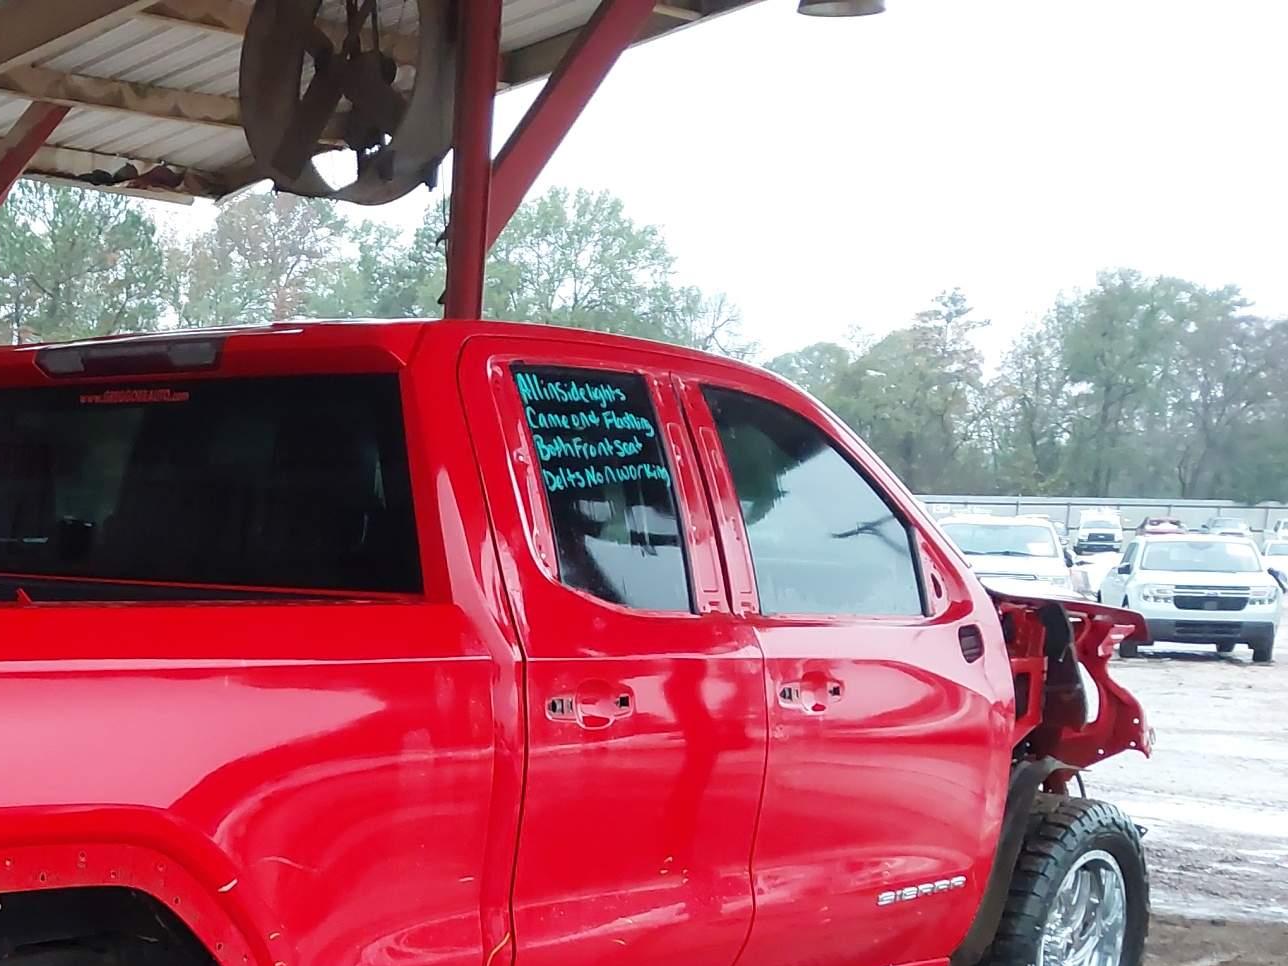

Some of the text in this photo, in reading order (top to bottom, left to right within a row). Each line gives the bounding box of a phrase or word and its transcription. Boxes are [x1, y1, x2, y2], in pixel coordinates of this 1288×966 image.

[516, 373, 541, 403] All
[586, 383, 626, 408] lights
[526, 406, 570, 429] Came
[533, 434, 571, 461] Both
[571, 437, 614, 459] Front
[877, 876, 967, 906] SIERRA
